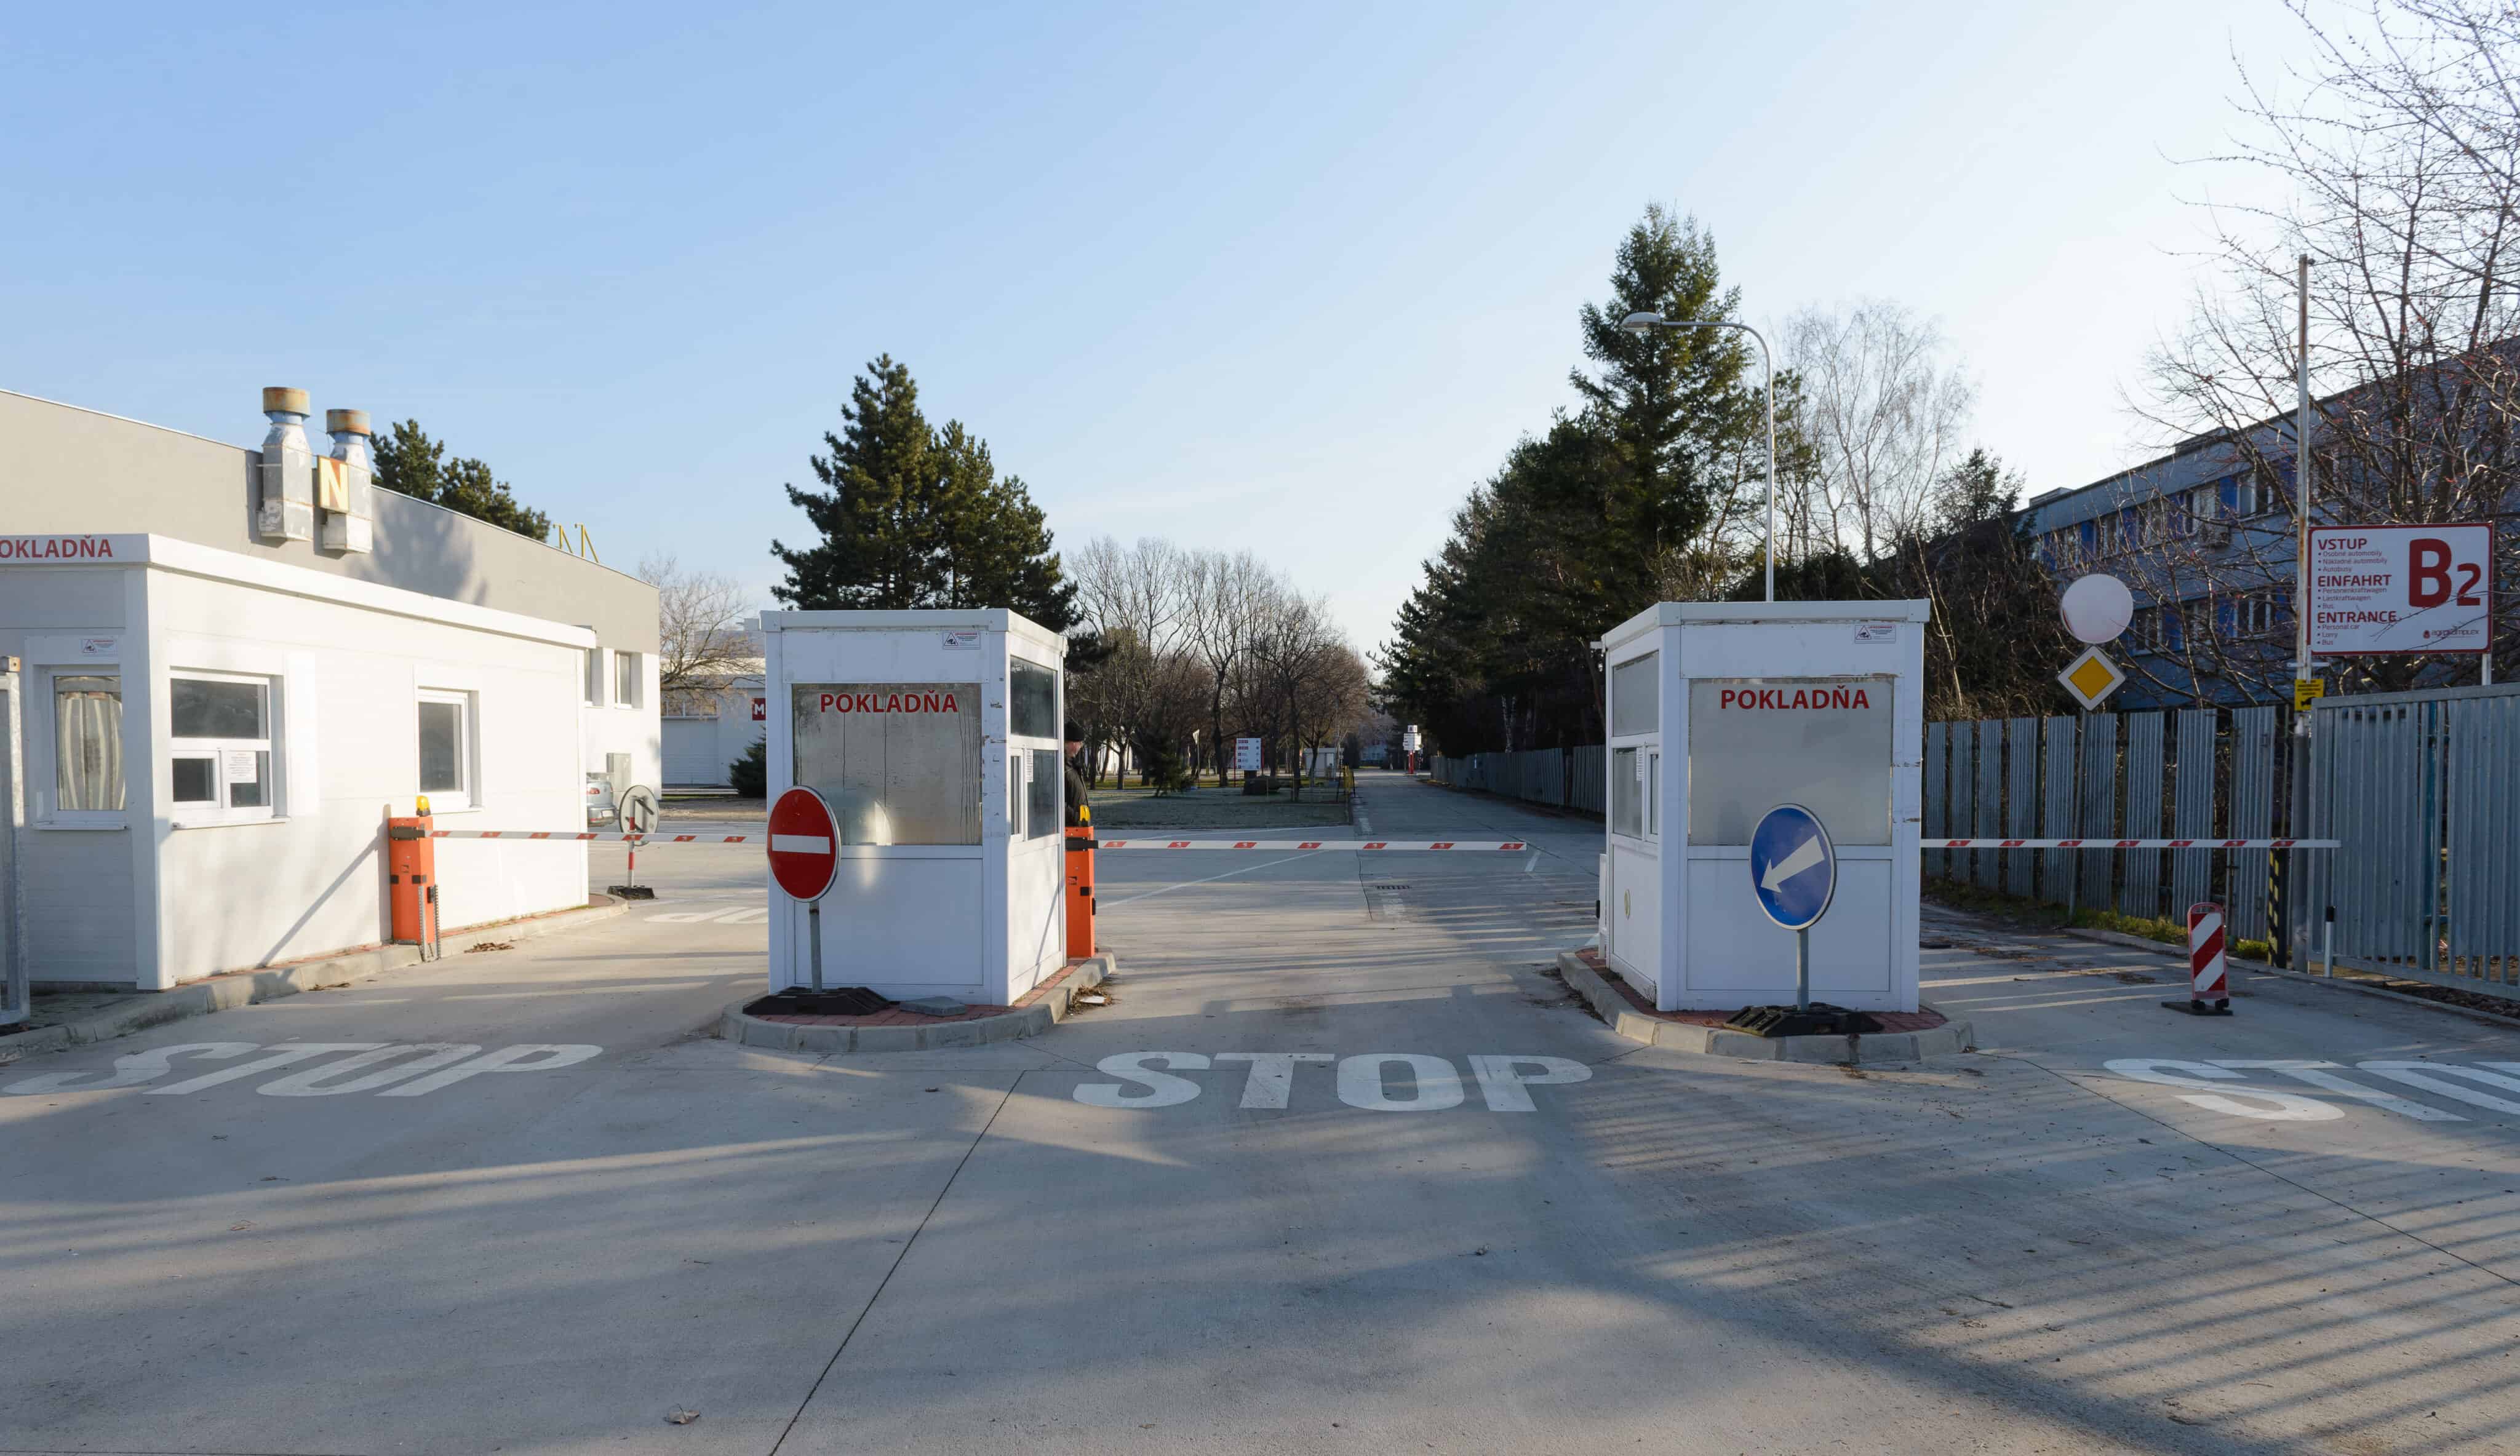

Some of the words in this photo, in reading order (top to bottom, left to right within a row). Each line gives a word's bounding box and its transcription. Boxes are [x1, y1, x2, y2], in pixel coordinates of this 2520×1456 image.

[2318, 538, 2367, 550] VSTUP
[2318, 575, 2392, 587] EINFAHRT
[2409, 538, 2481, 608] B2
[2317, 611, 2397, 623] ENTRANCE
[821, 690, 959, 713] POKLADŇA
[1720, 685, 1870, 709] POKLADŇA
[1, 1042, 604, 1097] STOP
[1073, 1051, 1593, 1112] STOP
